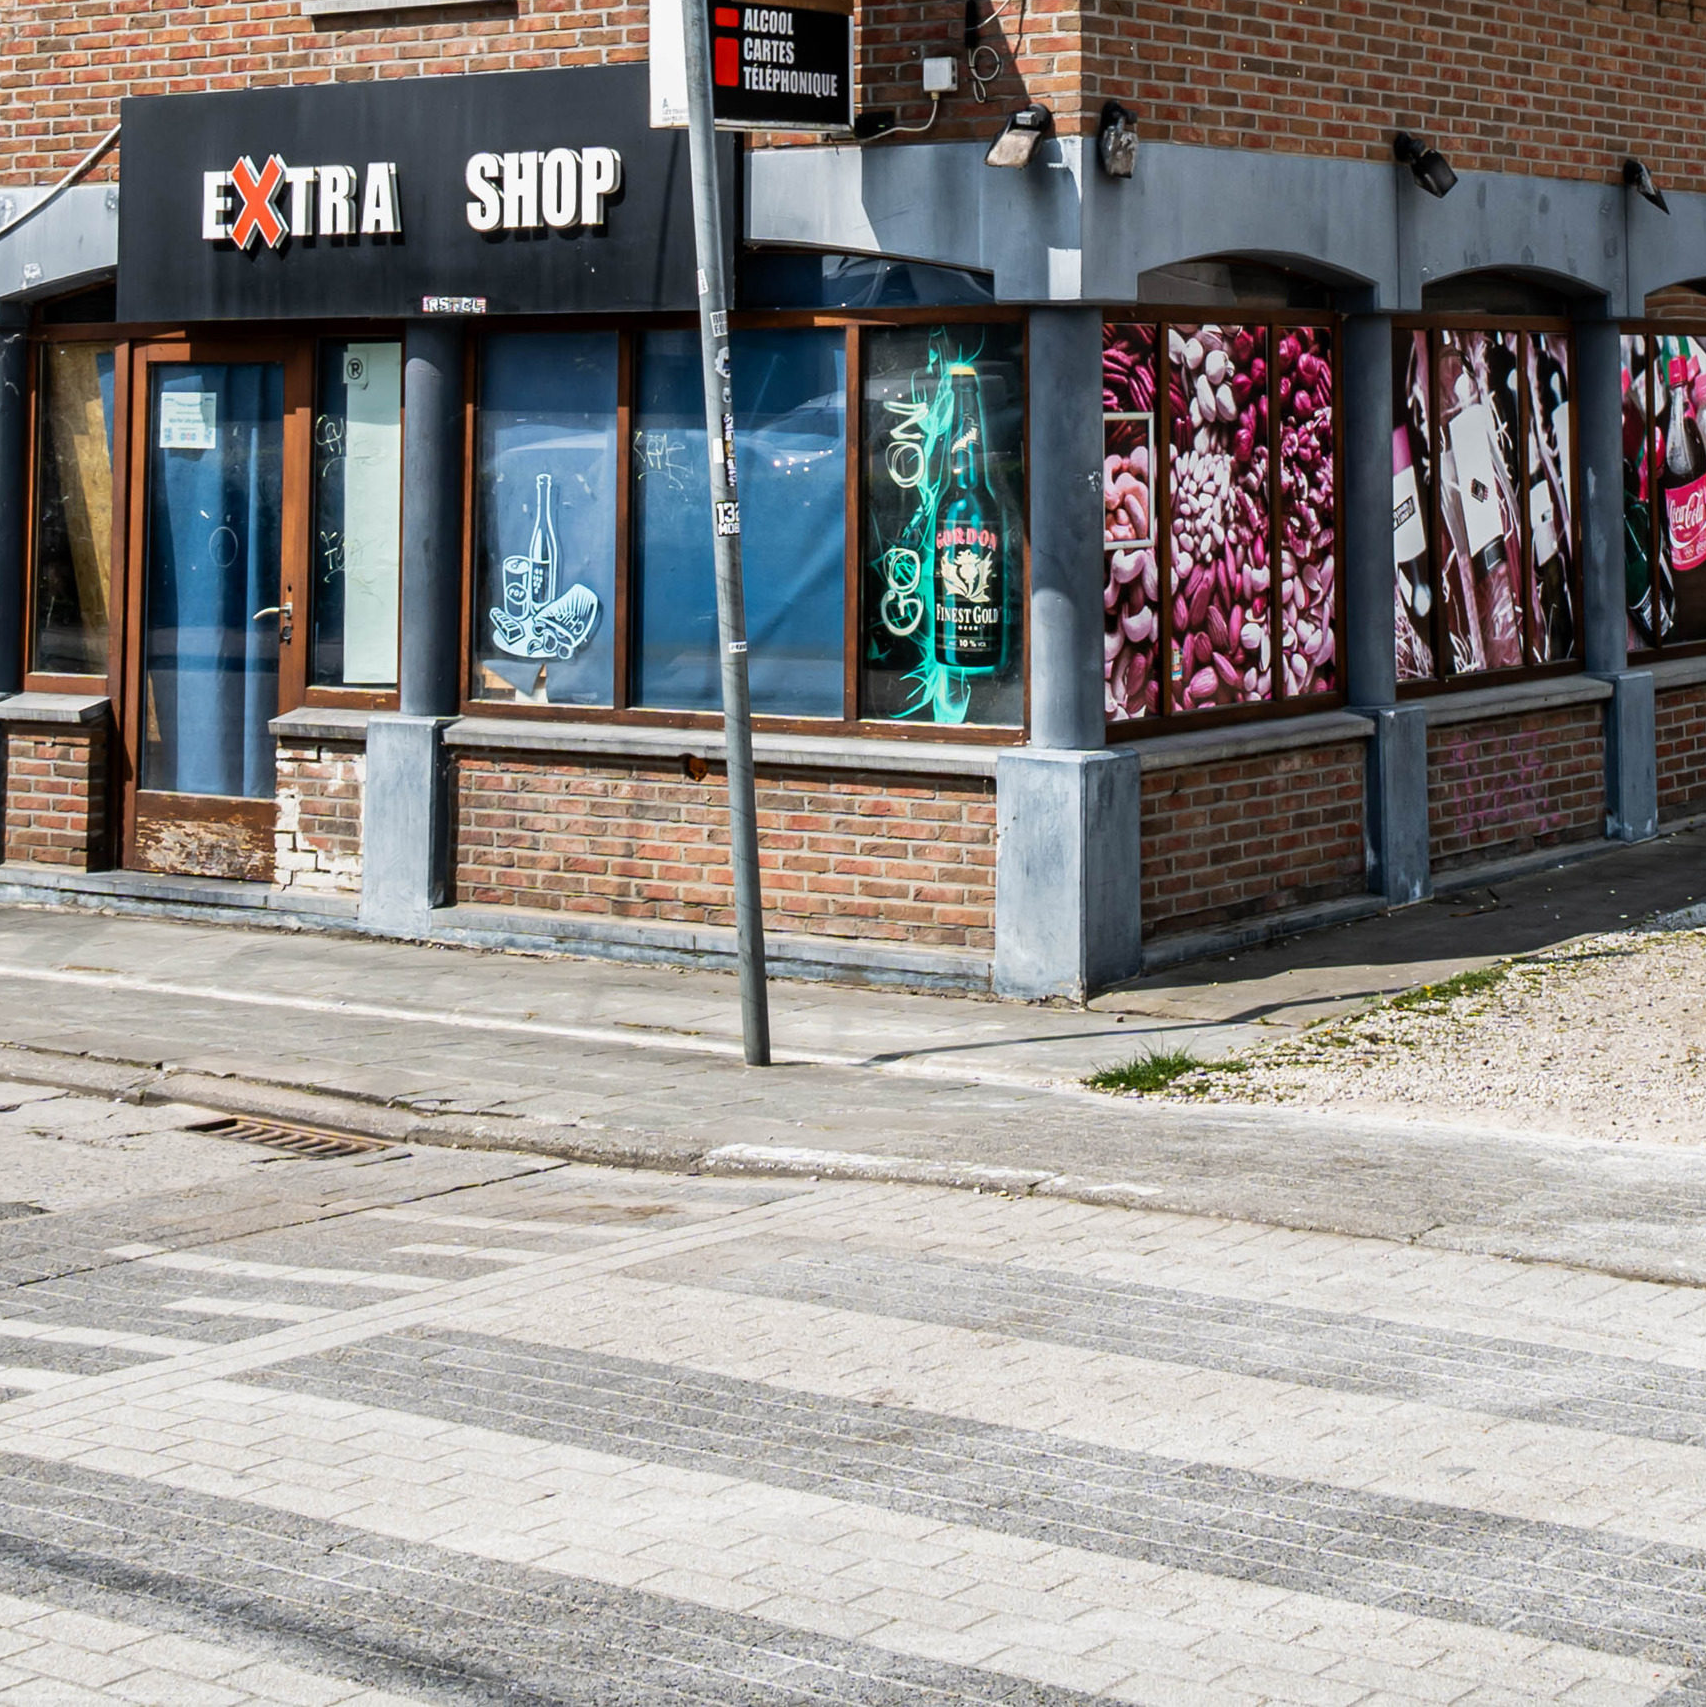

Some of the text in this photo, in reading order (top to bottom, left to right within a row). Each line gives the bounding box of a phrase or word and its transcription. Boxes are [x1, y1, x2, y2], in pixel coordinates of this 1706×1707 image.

[744, 8, 794, 35] ALCOOL
[744, 37, 795, 64] CARTES
[743, 64, 838, 98] TÉLÉPHONIQUE
[203, 147, 621, 250] EXTRA SHOP
[936, 526, 997, 552] GORDON
[509, 588, 524, 598] POP
[936, 603, 999, 624] FINEST GOLD
